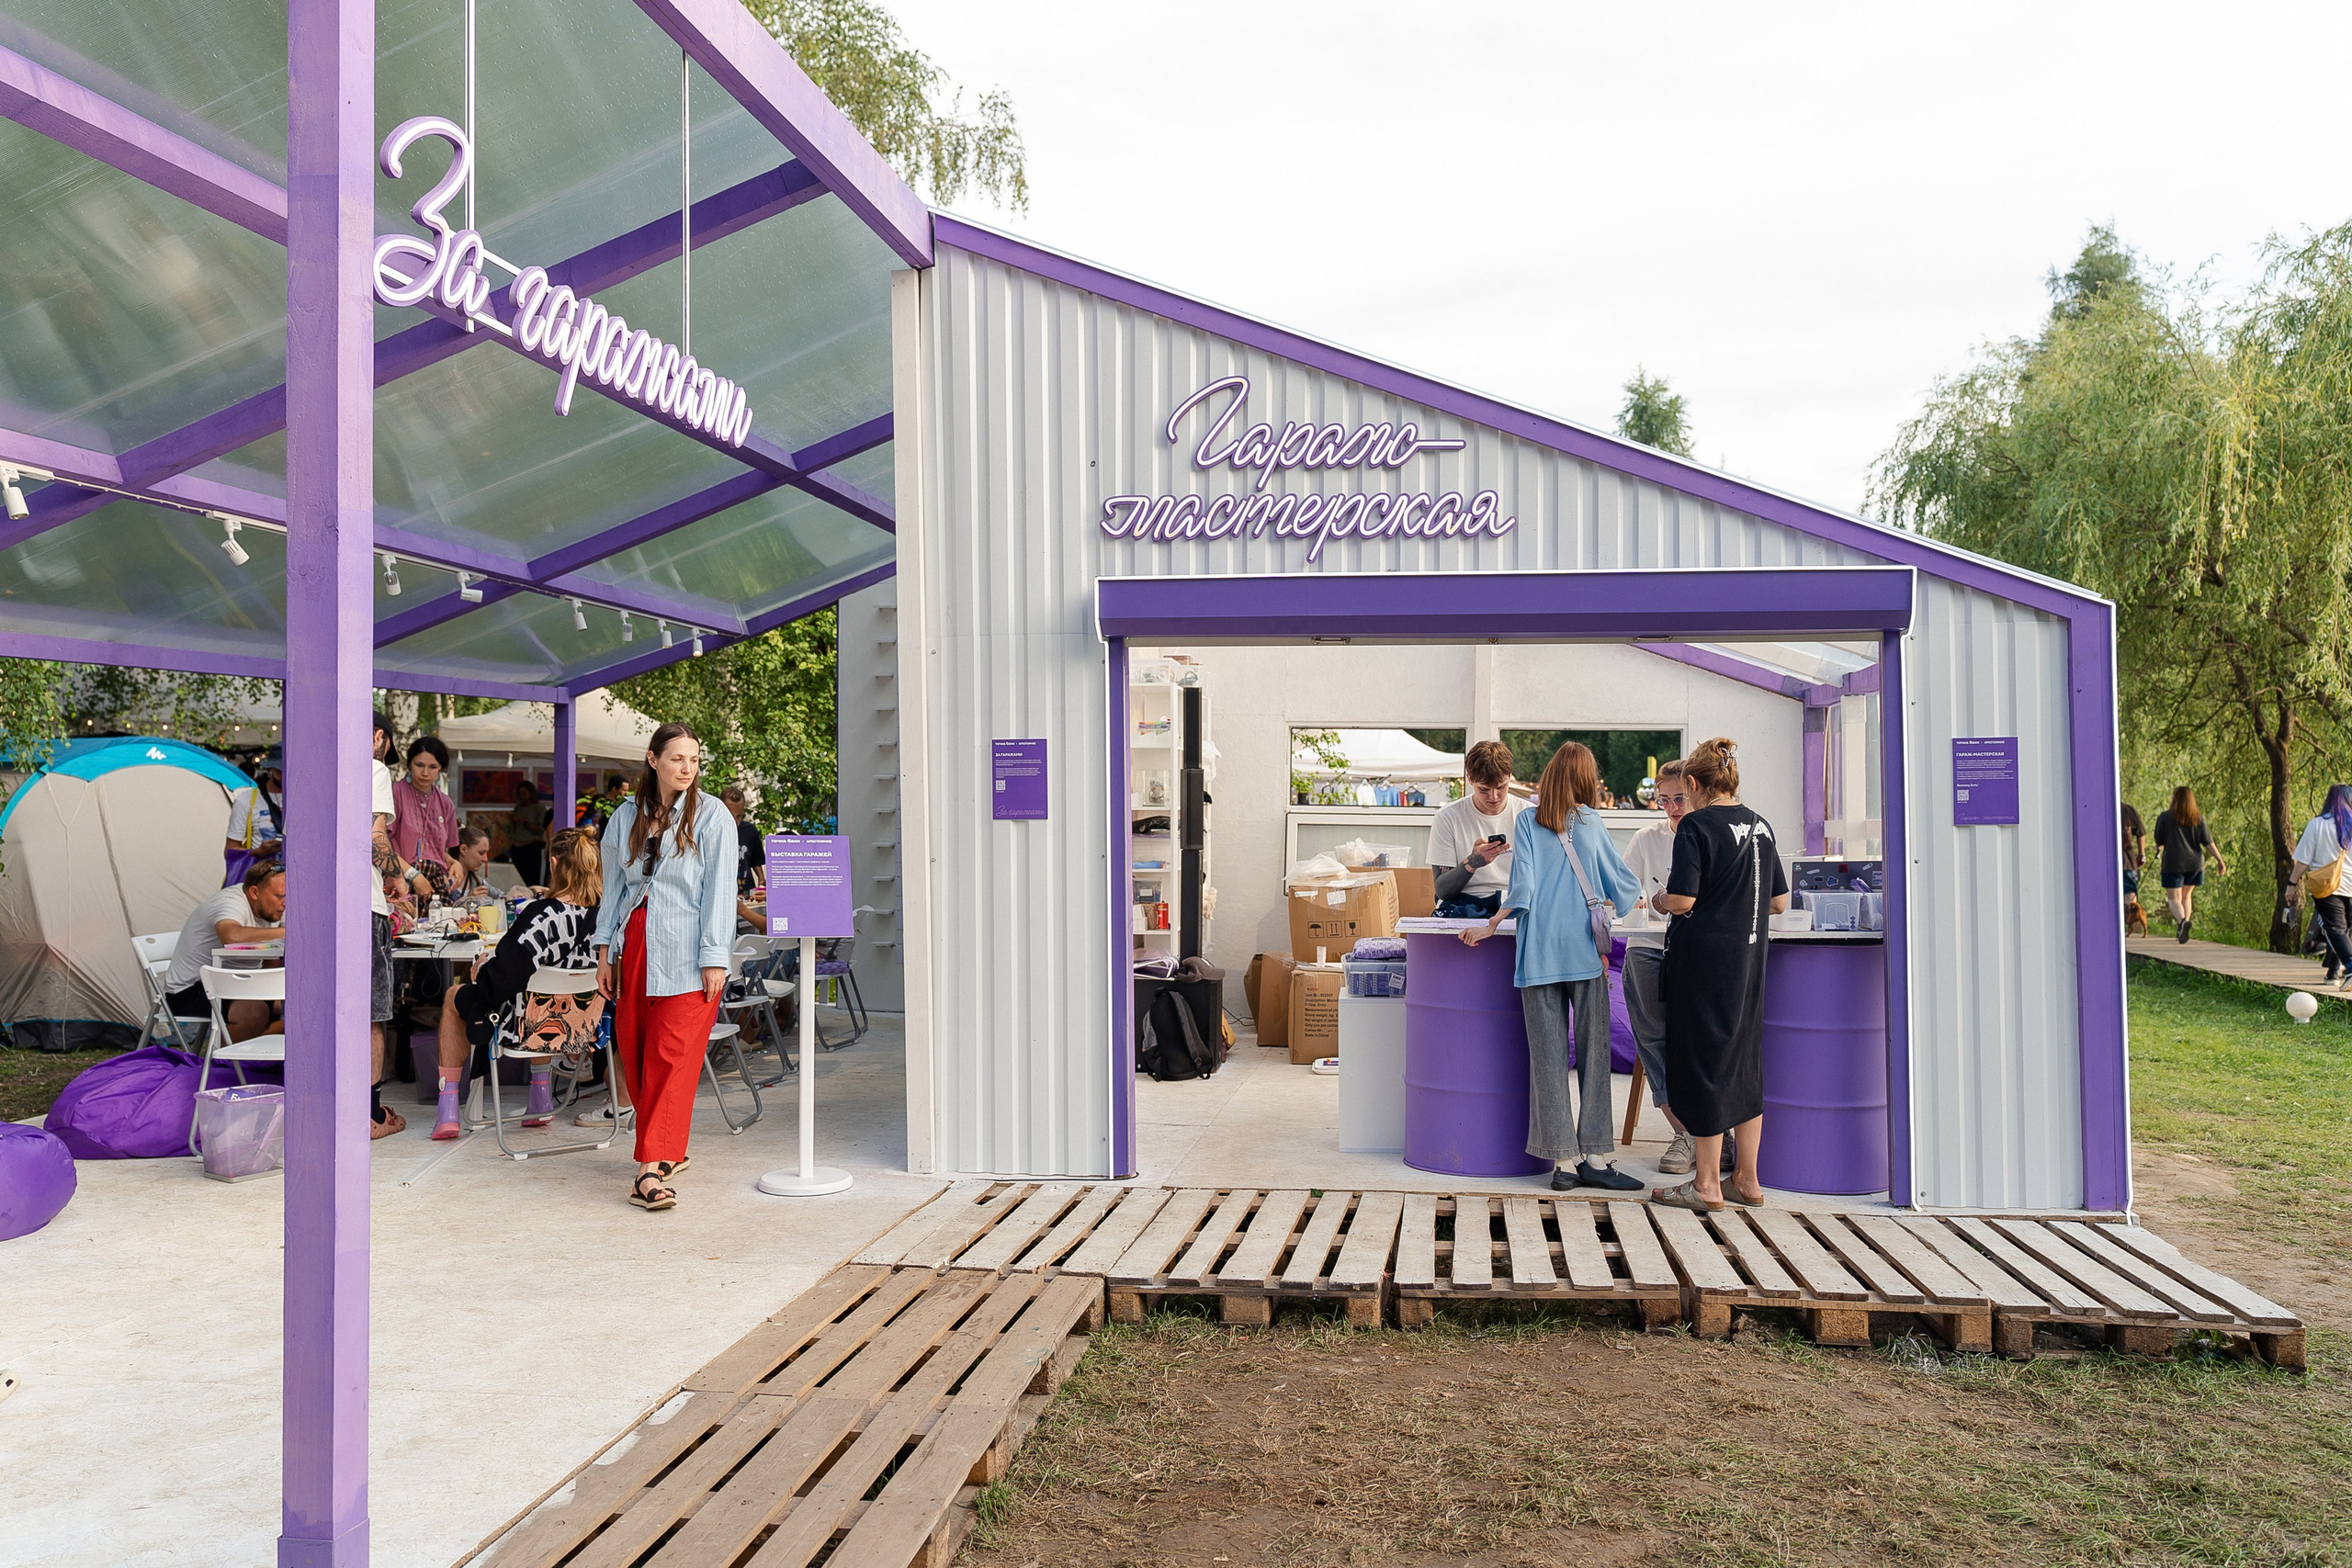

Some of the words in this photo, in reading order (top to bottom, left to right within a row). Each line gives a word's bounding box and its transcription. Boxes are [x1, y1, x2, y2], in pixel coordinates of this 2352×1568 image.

[373, 116, 490, 317] За
[509, 266, 753, 448] гаражами
[1100, 489, 1517, 564] мастерская
